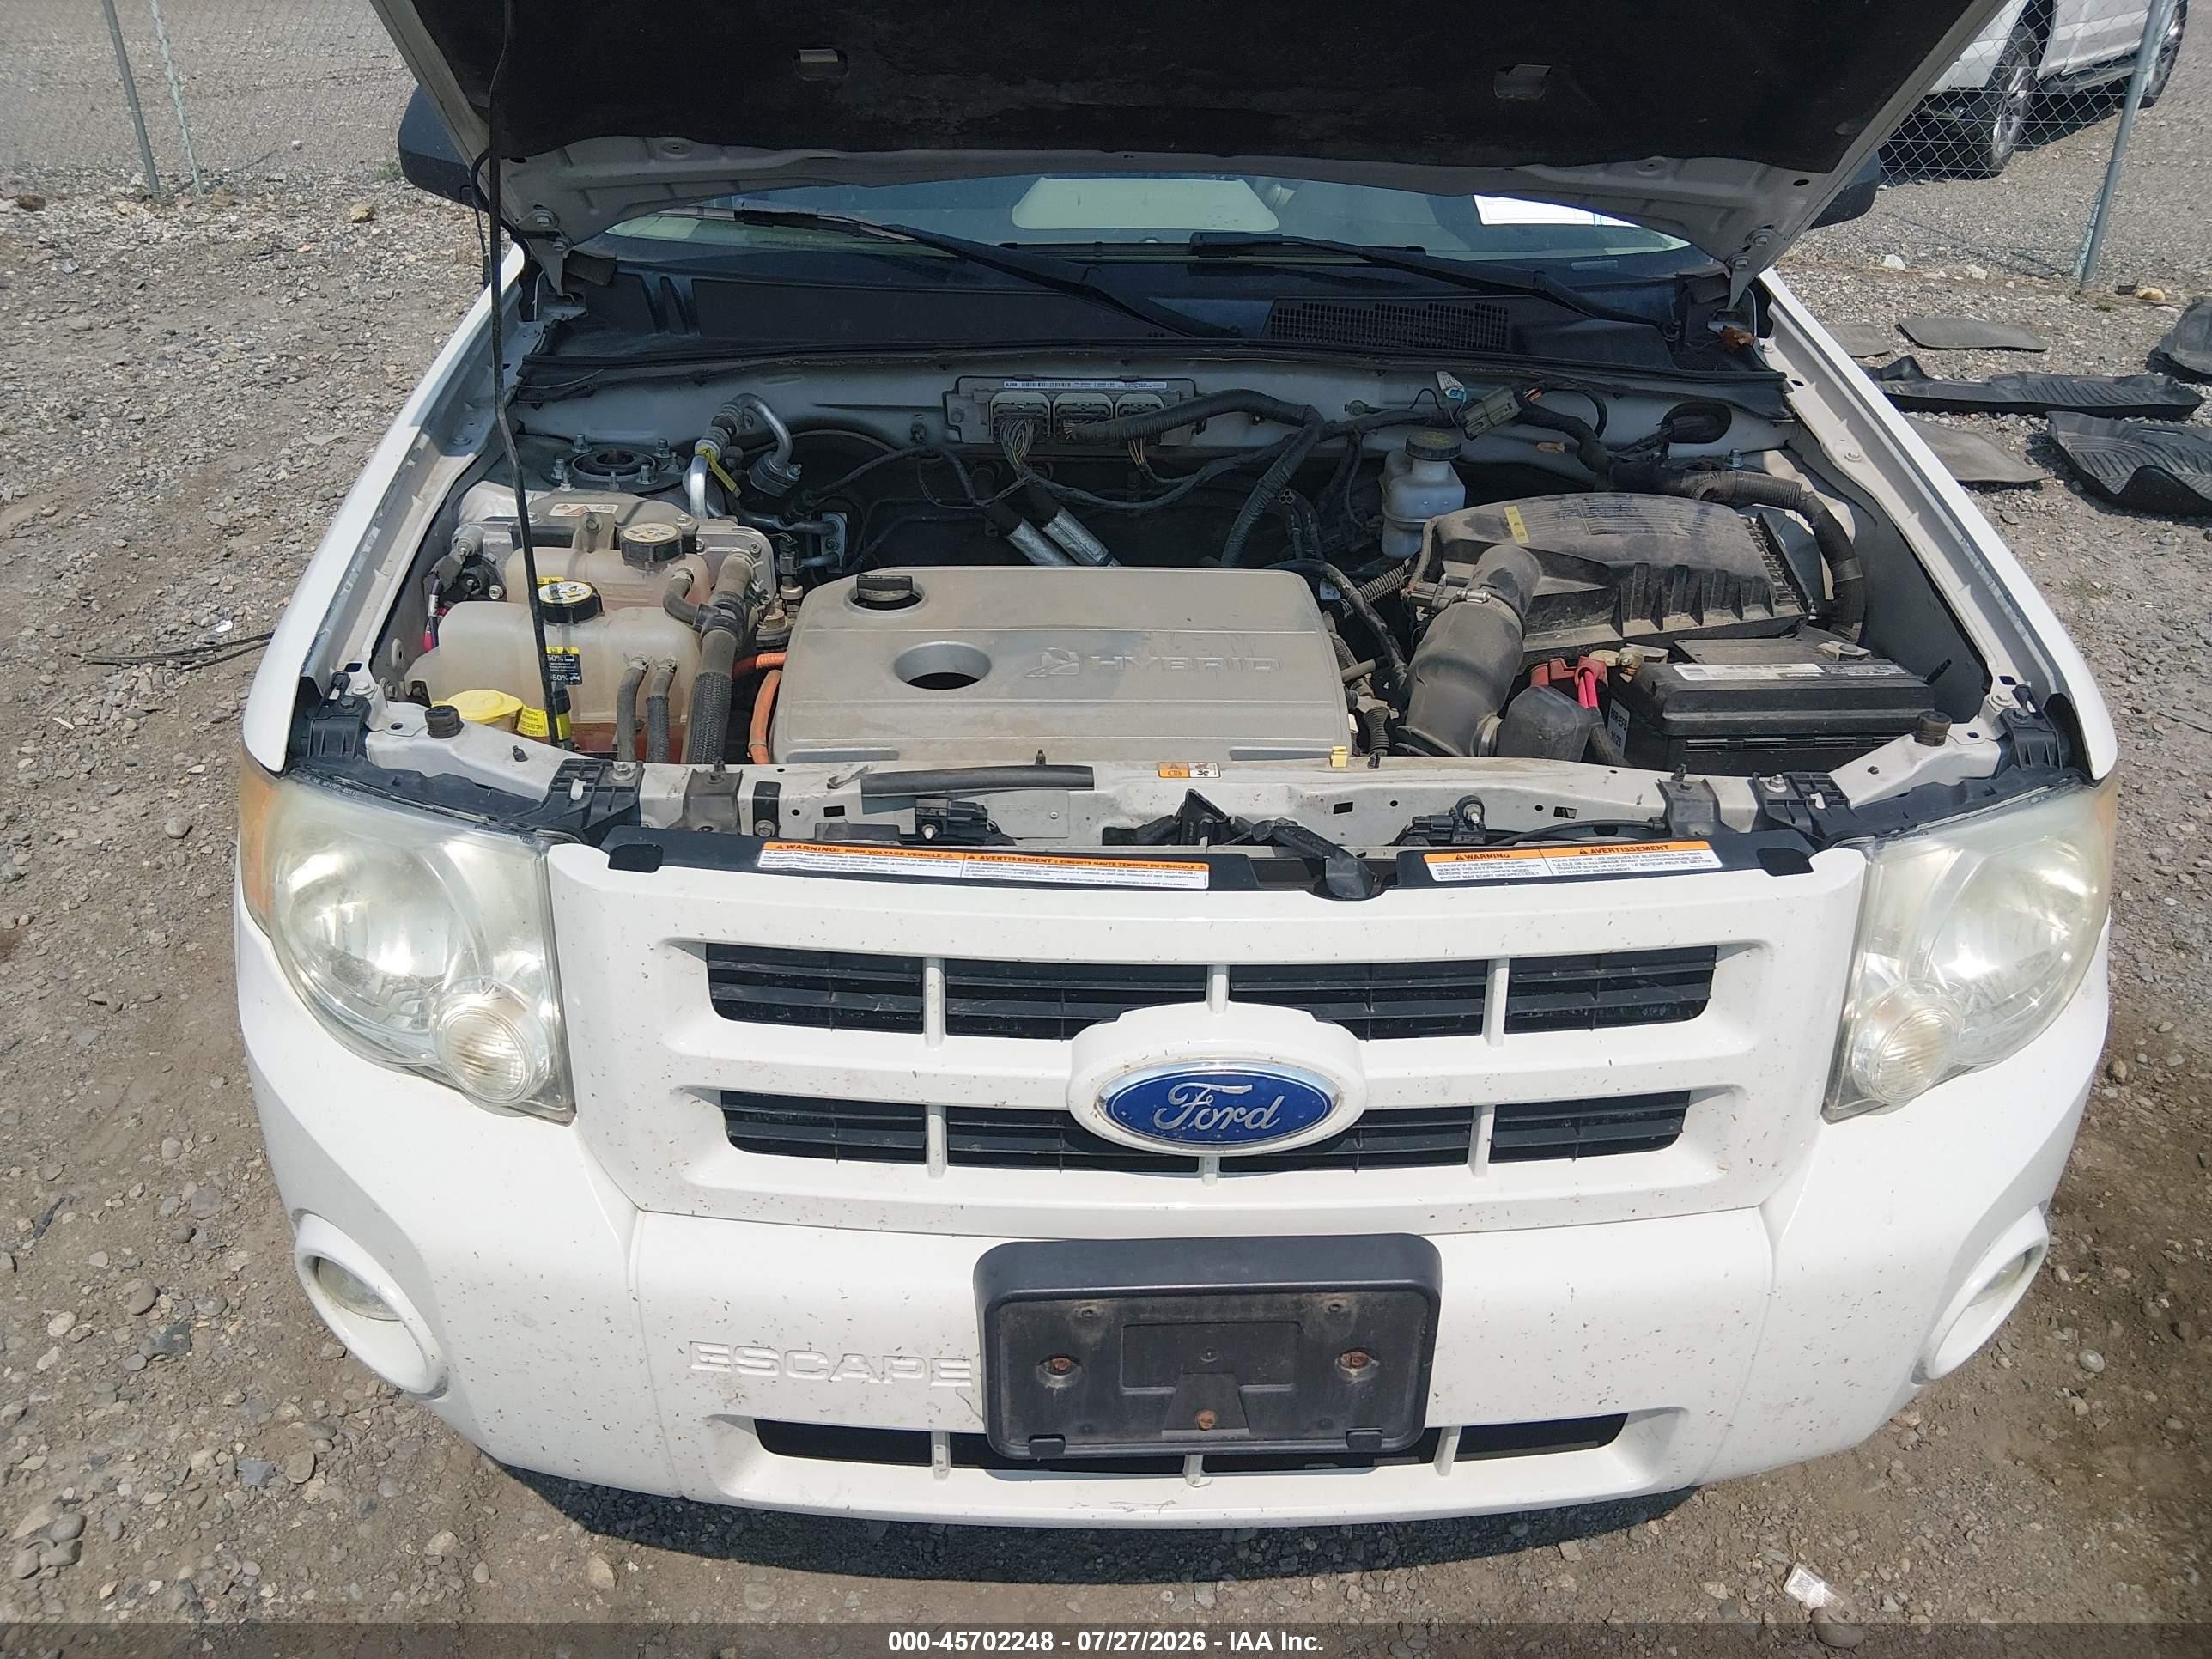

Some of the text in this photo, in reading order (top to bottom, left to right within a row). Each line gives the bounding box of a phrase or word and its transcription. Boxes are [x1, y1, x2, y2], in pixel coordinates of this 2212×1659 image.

[1088, 654, 1283, 672] HYBRID
[786, 844, 840, 853] WARNING:
[1591, 845, 1669, 854] AVERTISSEMENT
[979, 855, 1052, 863] AVERTISSEMENT
[1155, 1082, 1284, 1130] Ford
[688, 1341, 972, 1386] ESCAPE
